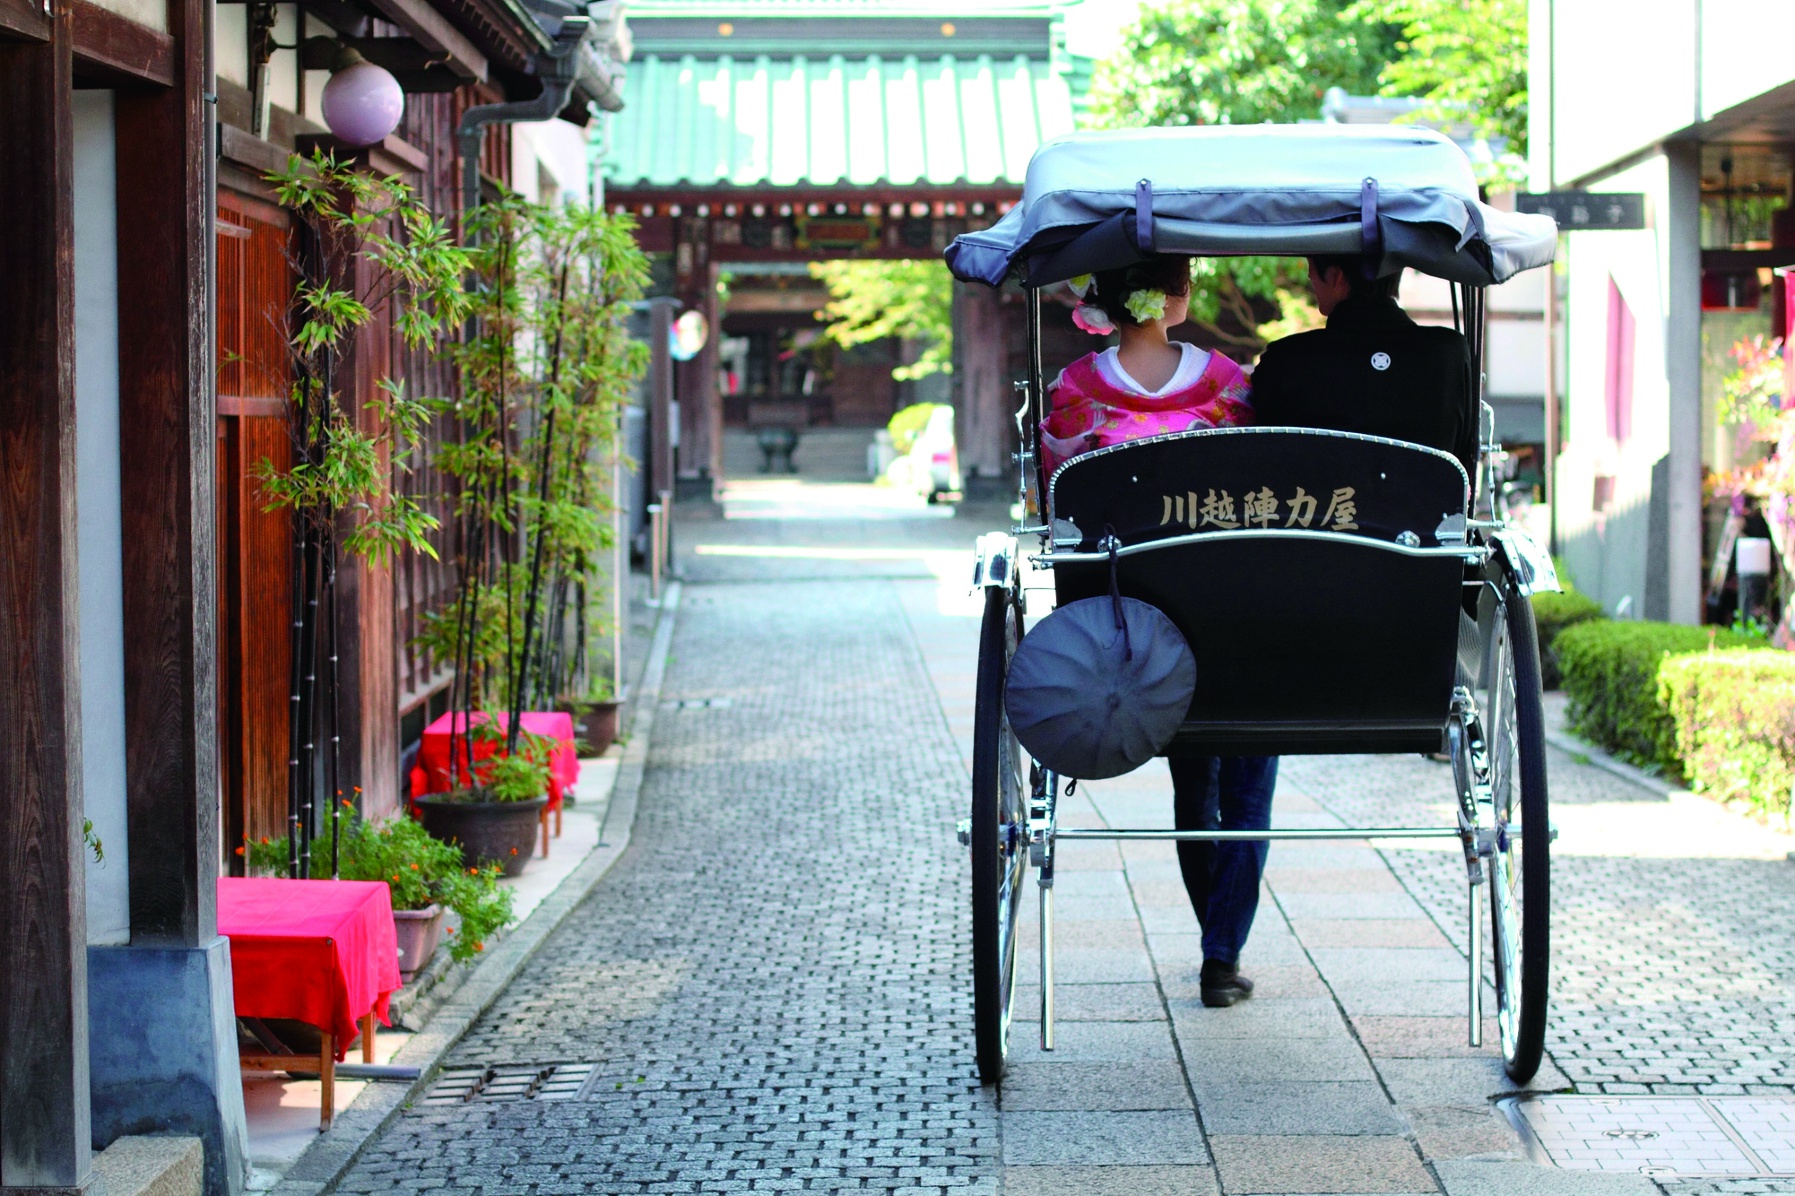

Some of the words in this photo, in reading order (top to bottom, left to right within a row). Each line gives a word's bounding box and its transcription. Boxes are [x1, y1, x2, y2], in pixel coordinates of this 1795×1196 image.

[1159, 486, 1359, 531] 川越陣力屋
